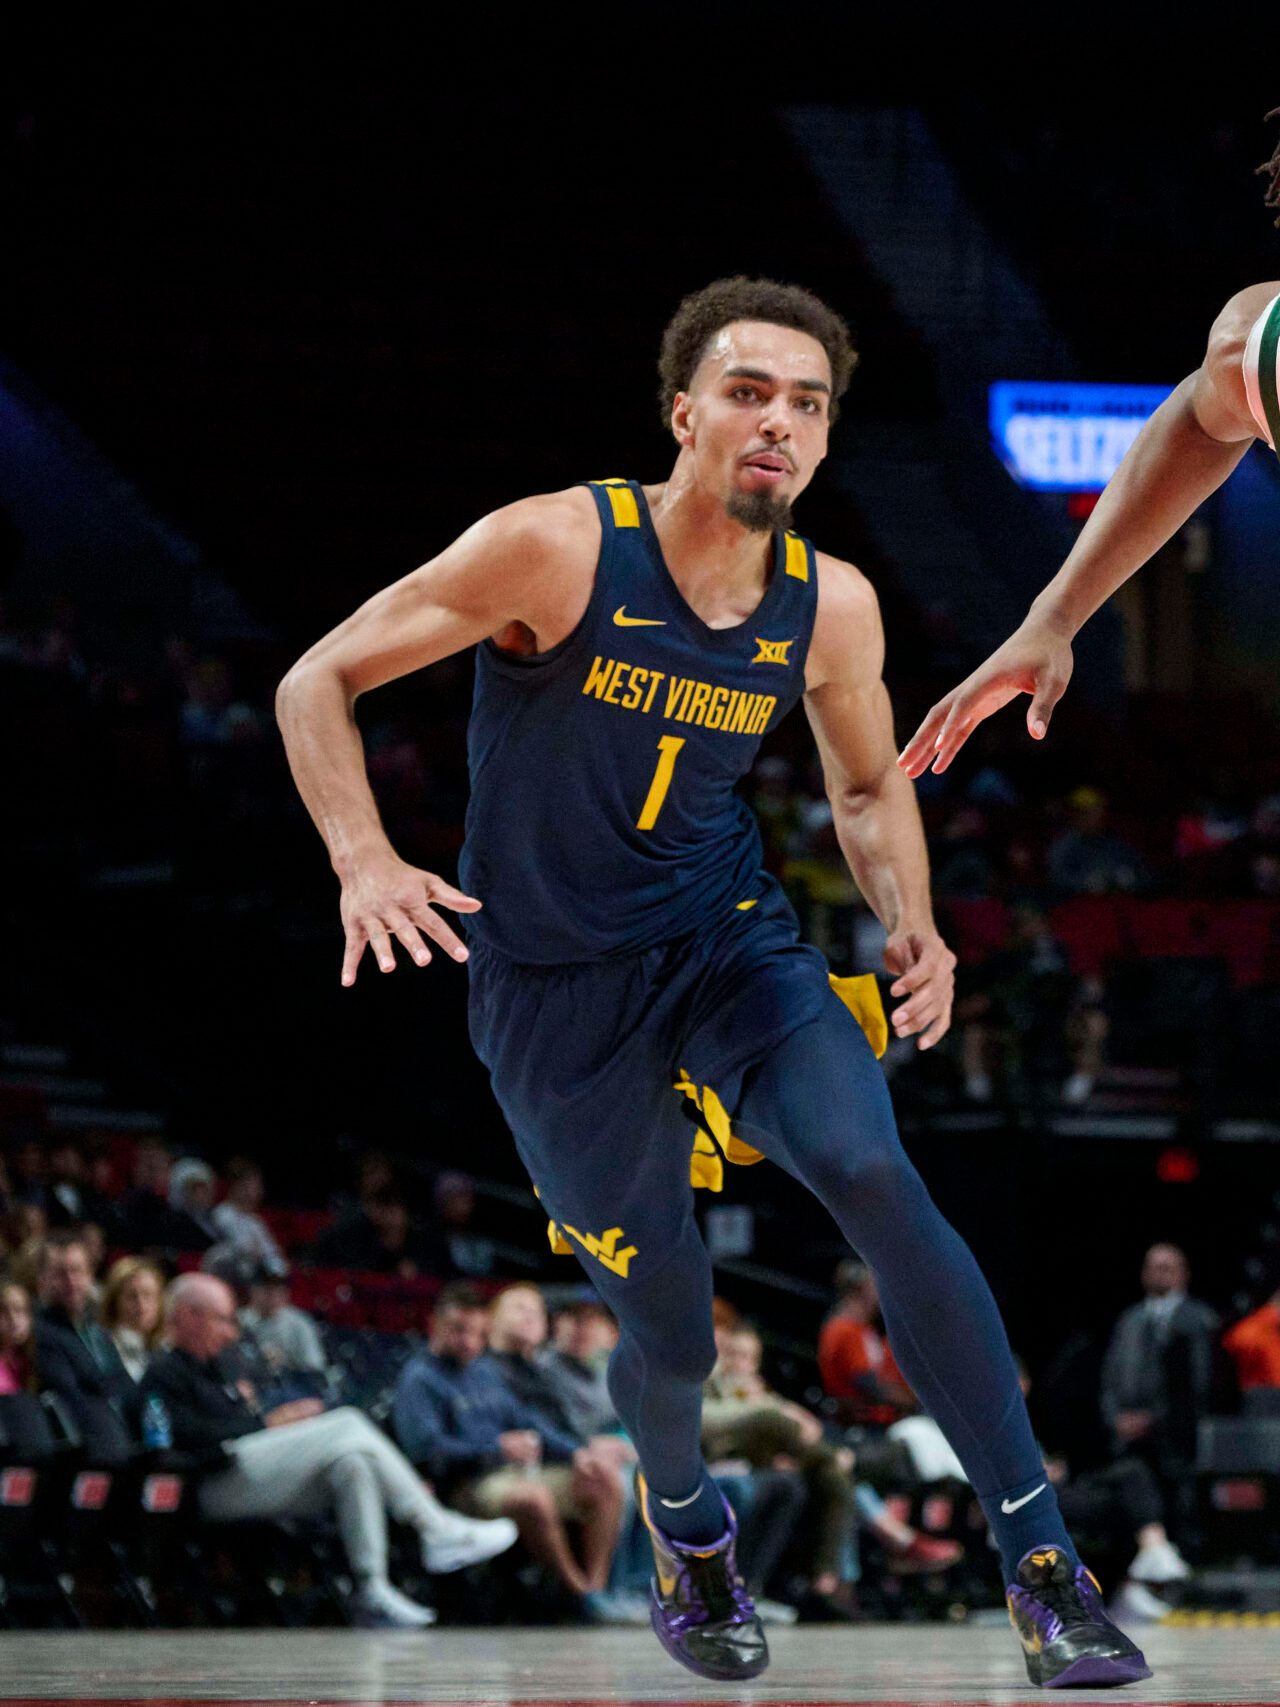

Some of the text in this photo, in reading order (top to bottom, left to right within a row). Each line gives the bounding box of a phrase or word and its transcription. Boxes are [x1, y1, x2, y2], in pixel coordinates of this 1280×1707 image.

[1004, 413, 1150, 484] SELTZ
[581, 655, 778, 736] WEST VIRGINIA
[635, 734, 687, 831] 1
